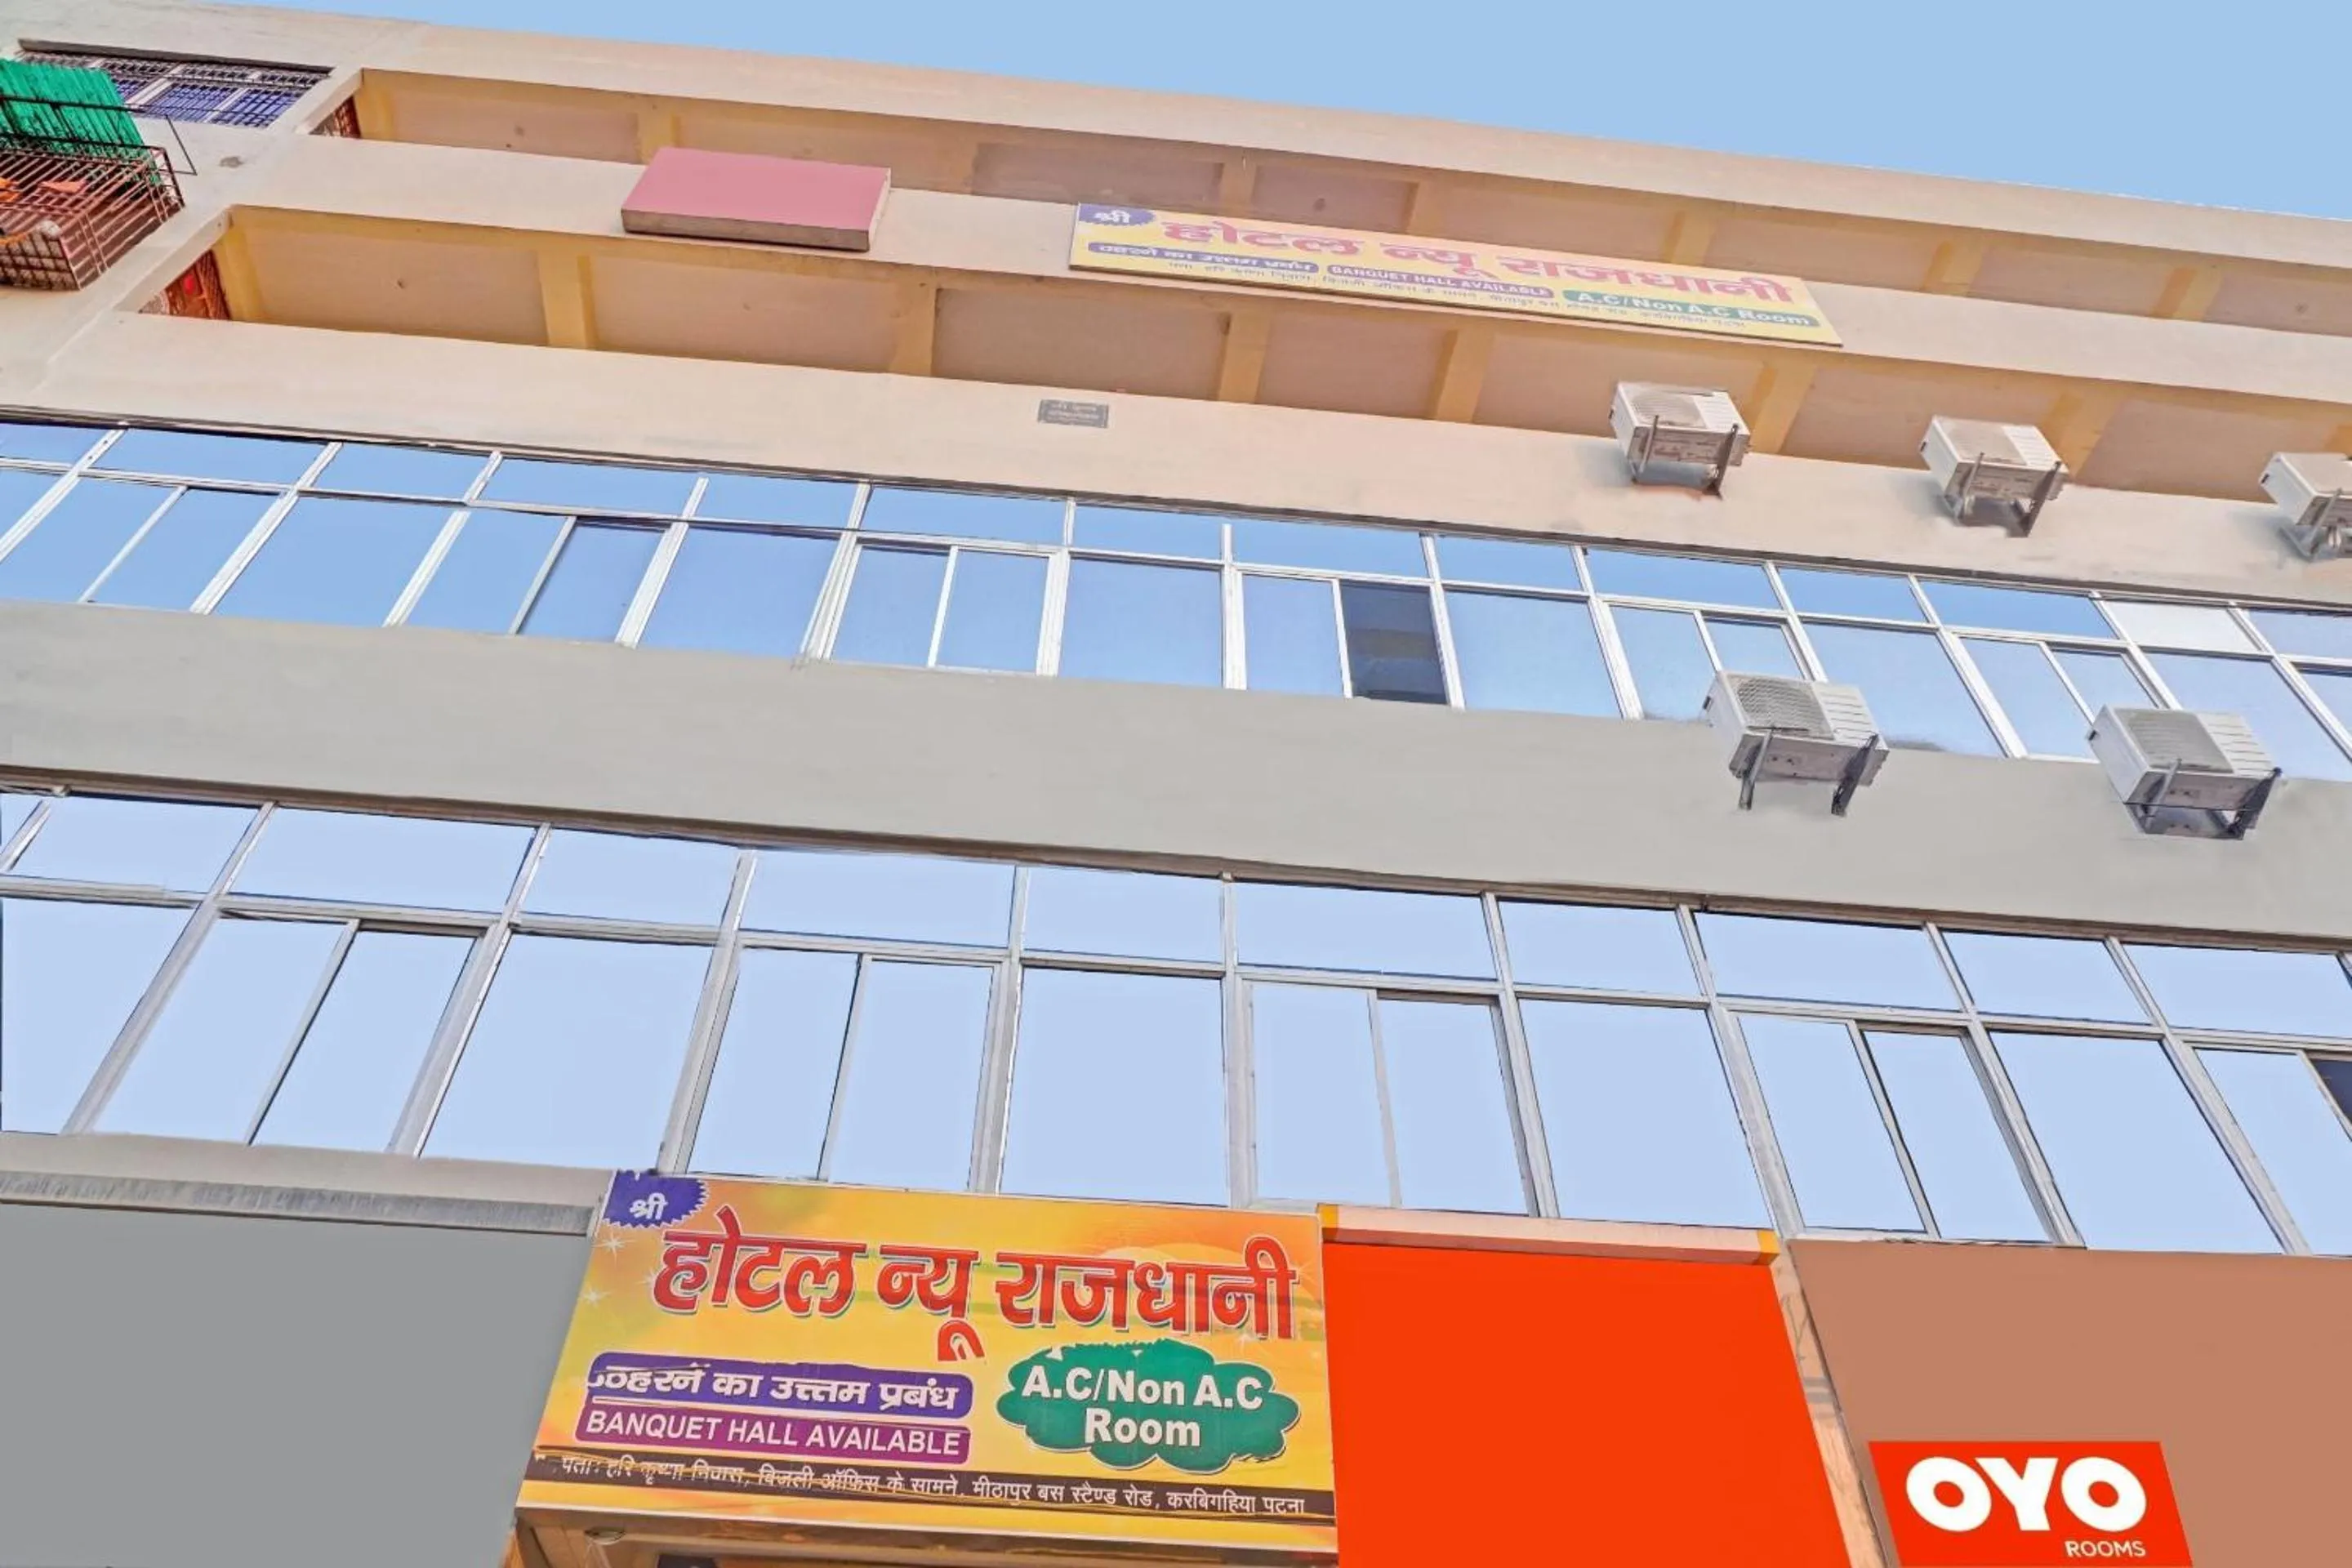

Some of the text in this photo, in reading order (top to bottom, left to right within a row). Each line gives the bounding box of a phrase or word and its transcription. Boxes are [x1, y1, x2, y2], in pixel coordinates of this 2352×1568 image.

[1161, 220, 1365, 256] होटल
[1496, 256, 1795, 303] राजधानी
[1331, 265, 1414, 285] BANQUET
[1414, 274, 1456, 287] HALL
[1738, 308, 1811, 326] Room
[630, 1192, 668, 1219] श्री
[653, 1205, 1298, 1361] होटल न्यू राजधानी
[712, 1373, 764, 1397] का
[770, 1375, 871, 1405] उत्तम
[879, 1378, 959, 1411] प्रबंध
[586, 1410, 961, 1455] BANQUET HALL AVAILABLE
[1085, 1407, 1200, 1446] Room
[886, 1470, 906, 1493] के
[972, 1475, 1032, 1505] मीठापुर
[1036, 1484, 1065, 1502] बस
[1262, 1495, 1305, 1516] पटना
[1906, 1456, 2147, 1532] OYO
[2065, 1540, 2147, 1558] ROOMS
